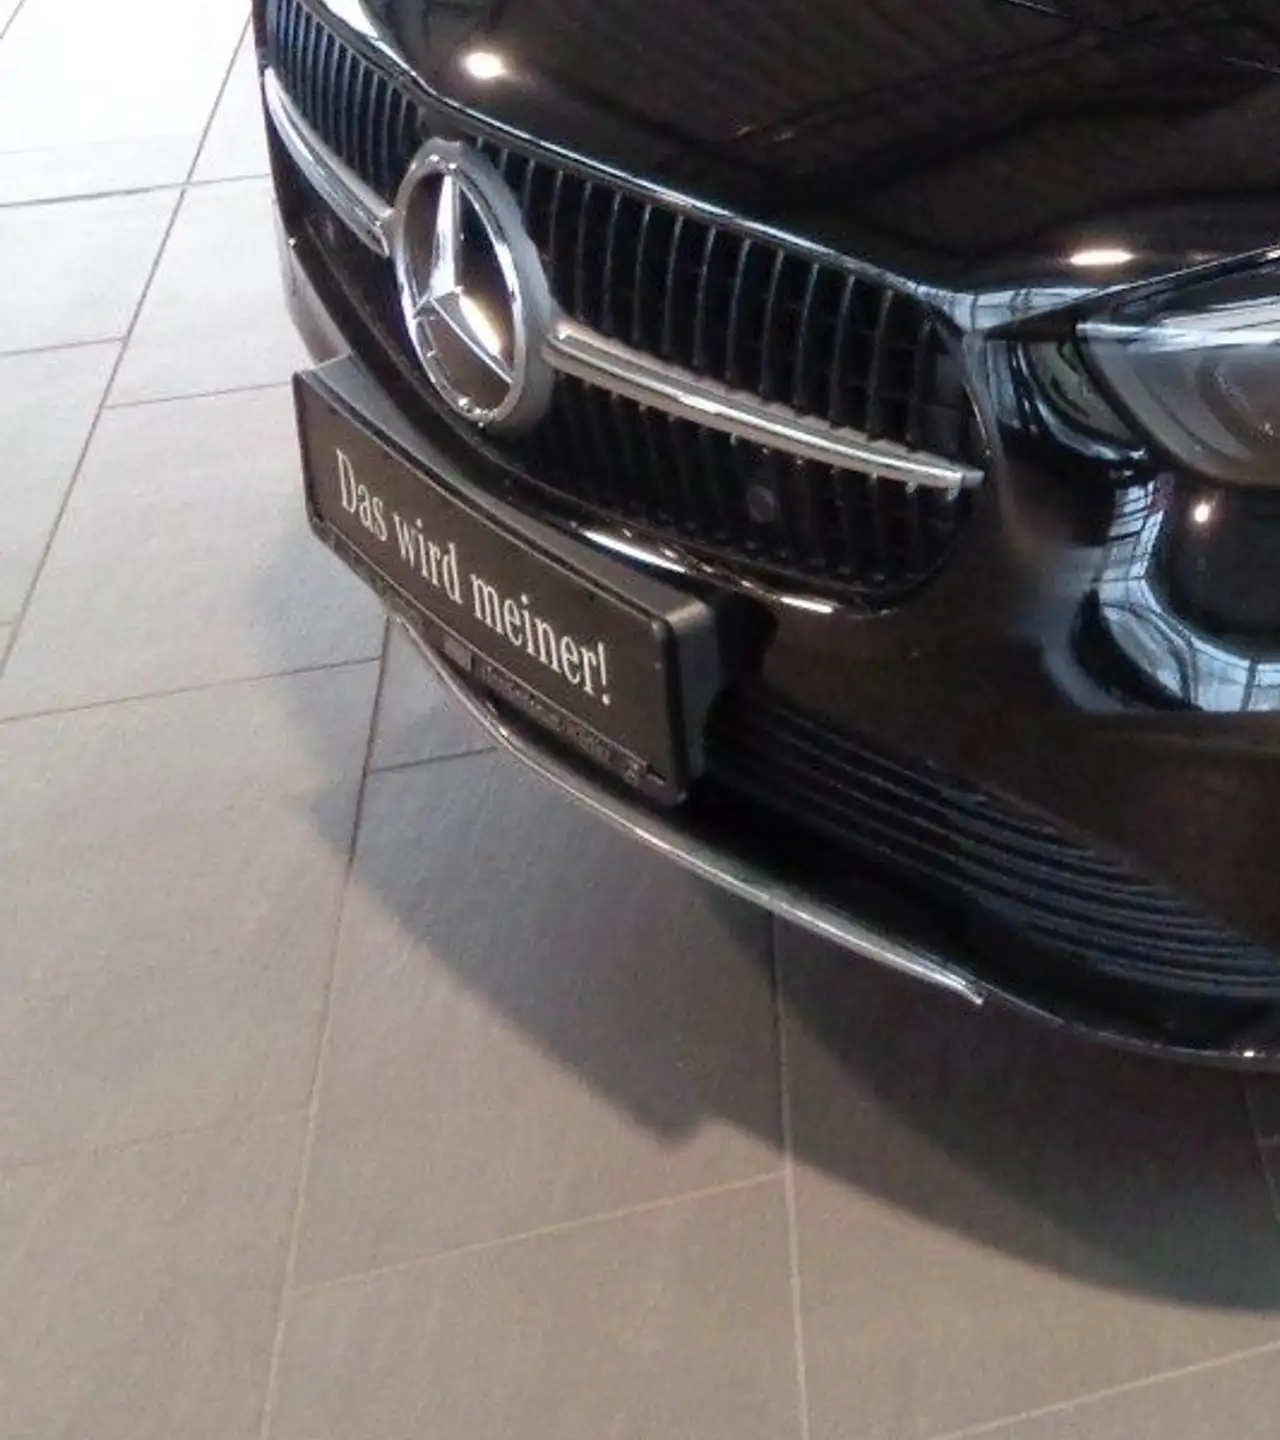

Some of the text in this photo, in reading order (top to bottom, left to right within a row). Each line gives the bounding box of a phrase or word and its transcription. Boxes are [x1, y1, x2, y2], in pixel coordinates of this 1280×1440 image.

[335, 448, 612, 706] Das wird meiner!
